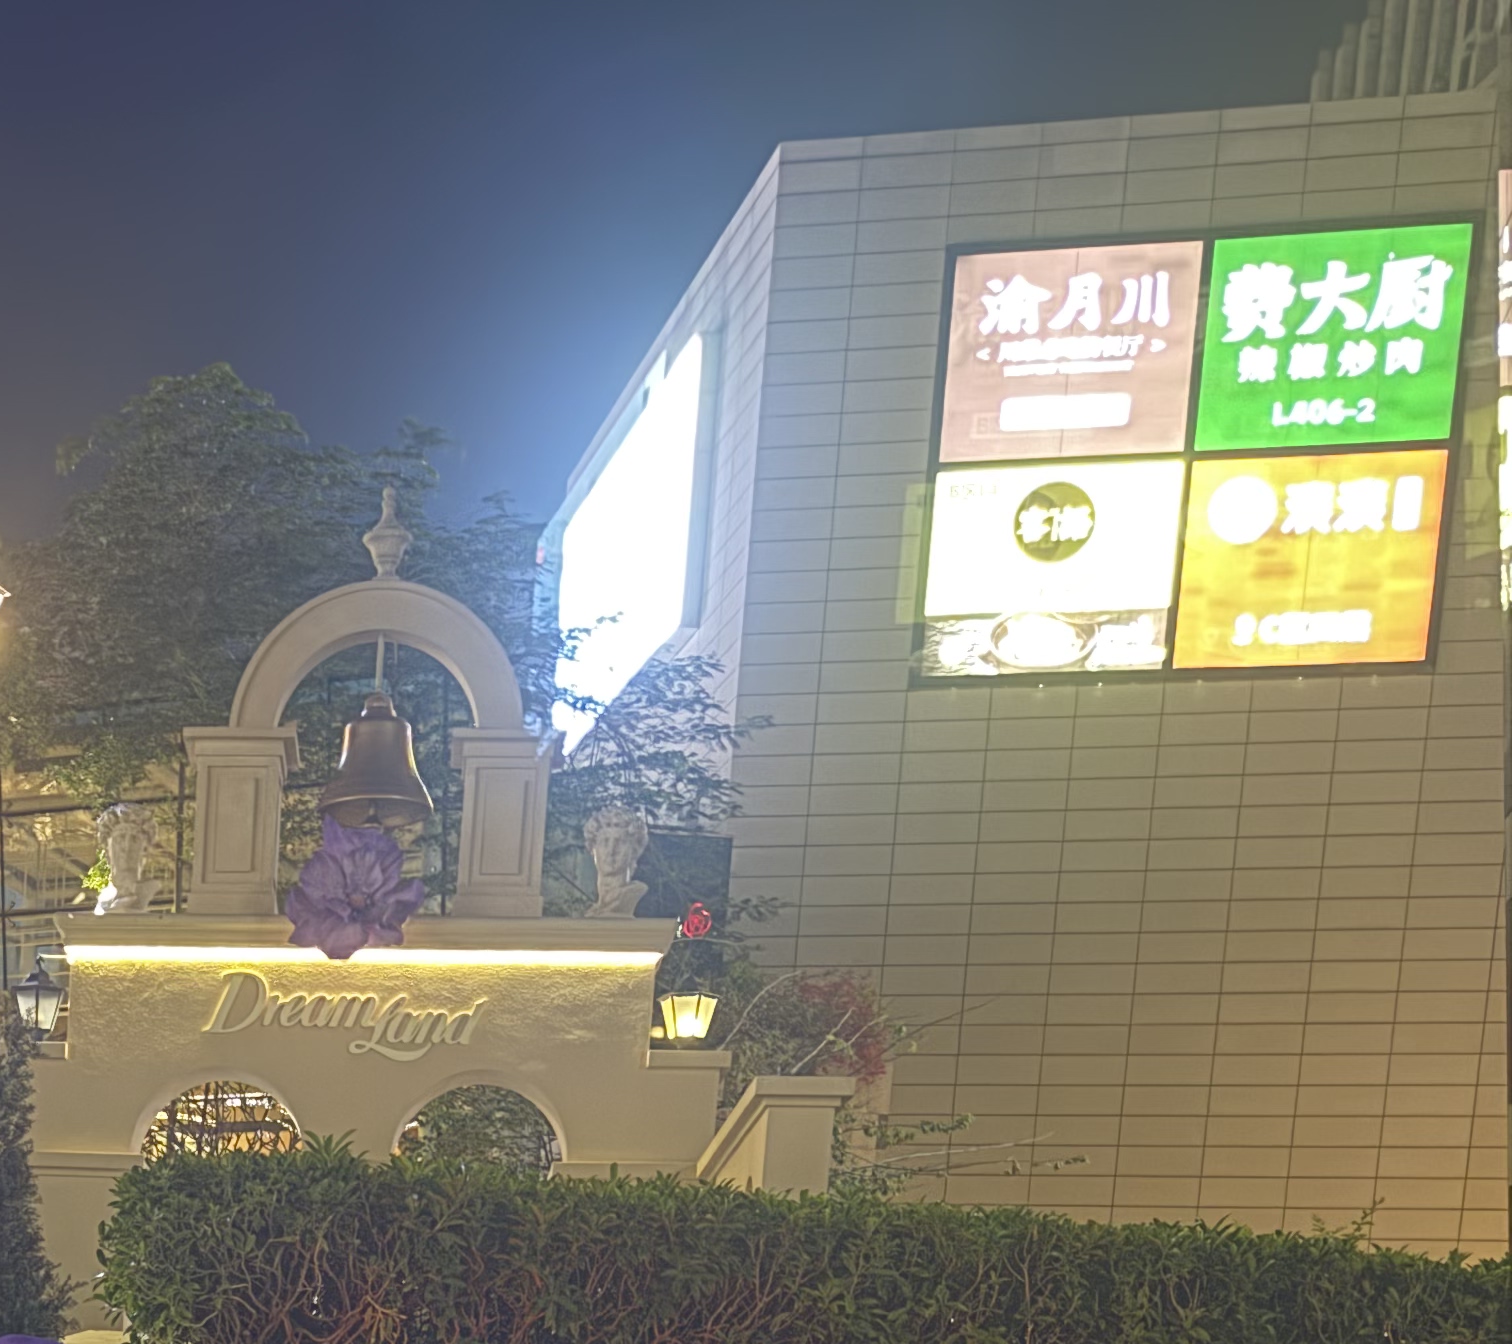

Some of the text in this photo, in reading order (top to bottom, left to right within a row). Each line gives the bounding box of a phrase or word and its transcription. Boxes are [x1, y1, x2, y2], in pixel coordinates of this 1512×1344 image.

[979, 271, 1170, 335] 渝月川
[1221, 252, 1453, 342] 费大厨
[1272, 398, 1376, 426] L406-2
[201, 968, 489, 1062] Dream Land
